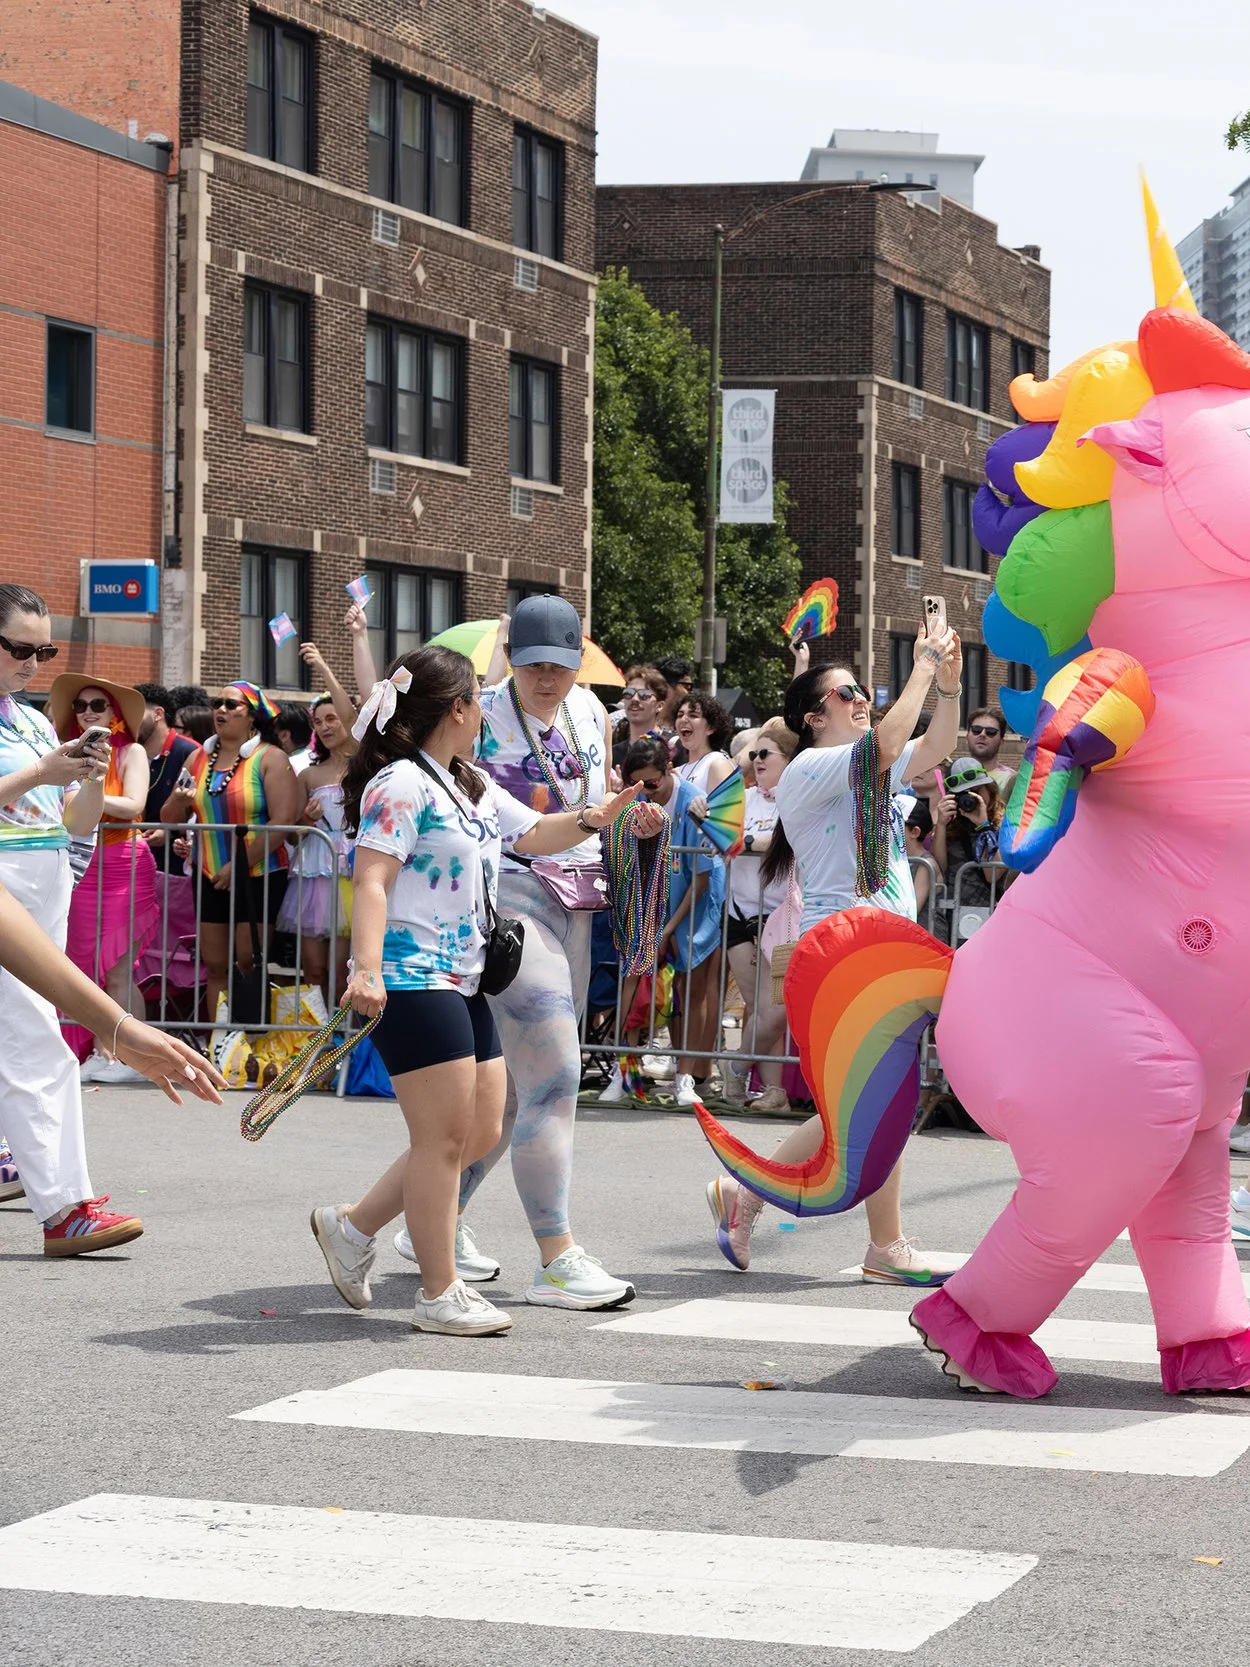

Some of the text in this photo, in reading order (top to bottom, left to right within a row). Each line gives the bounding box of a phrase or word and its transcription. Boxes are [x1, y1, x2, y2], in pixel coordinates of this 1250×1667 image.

[732, 403, 765, 419] third
[729, 419, 766, 432] space
[731, 463, 764, 479] third
[728, 480, 766, 493] space
[94, 584, 122, 594] BMO
